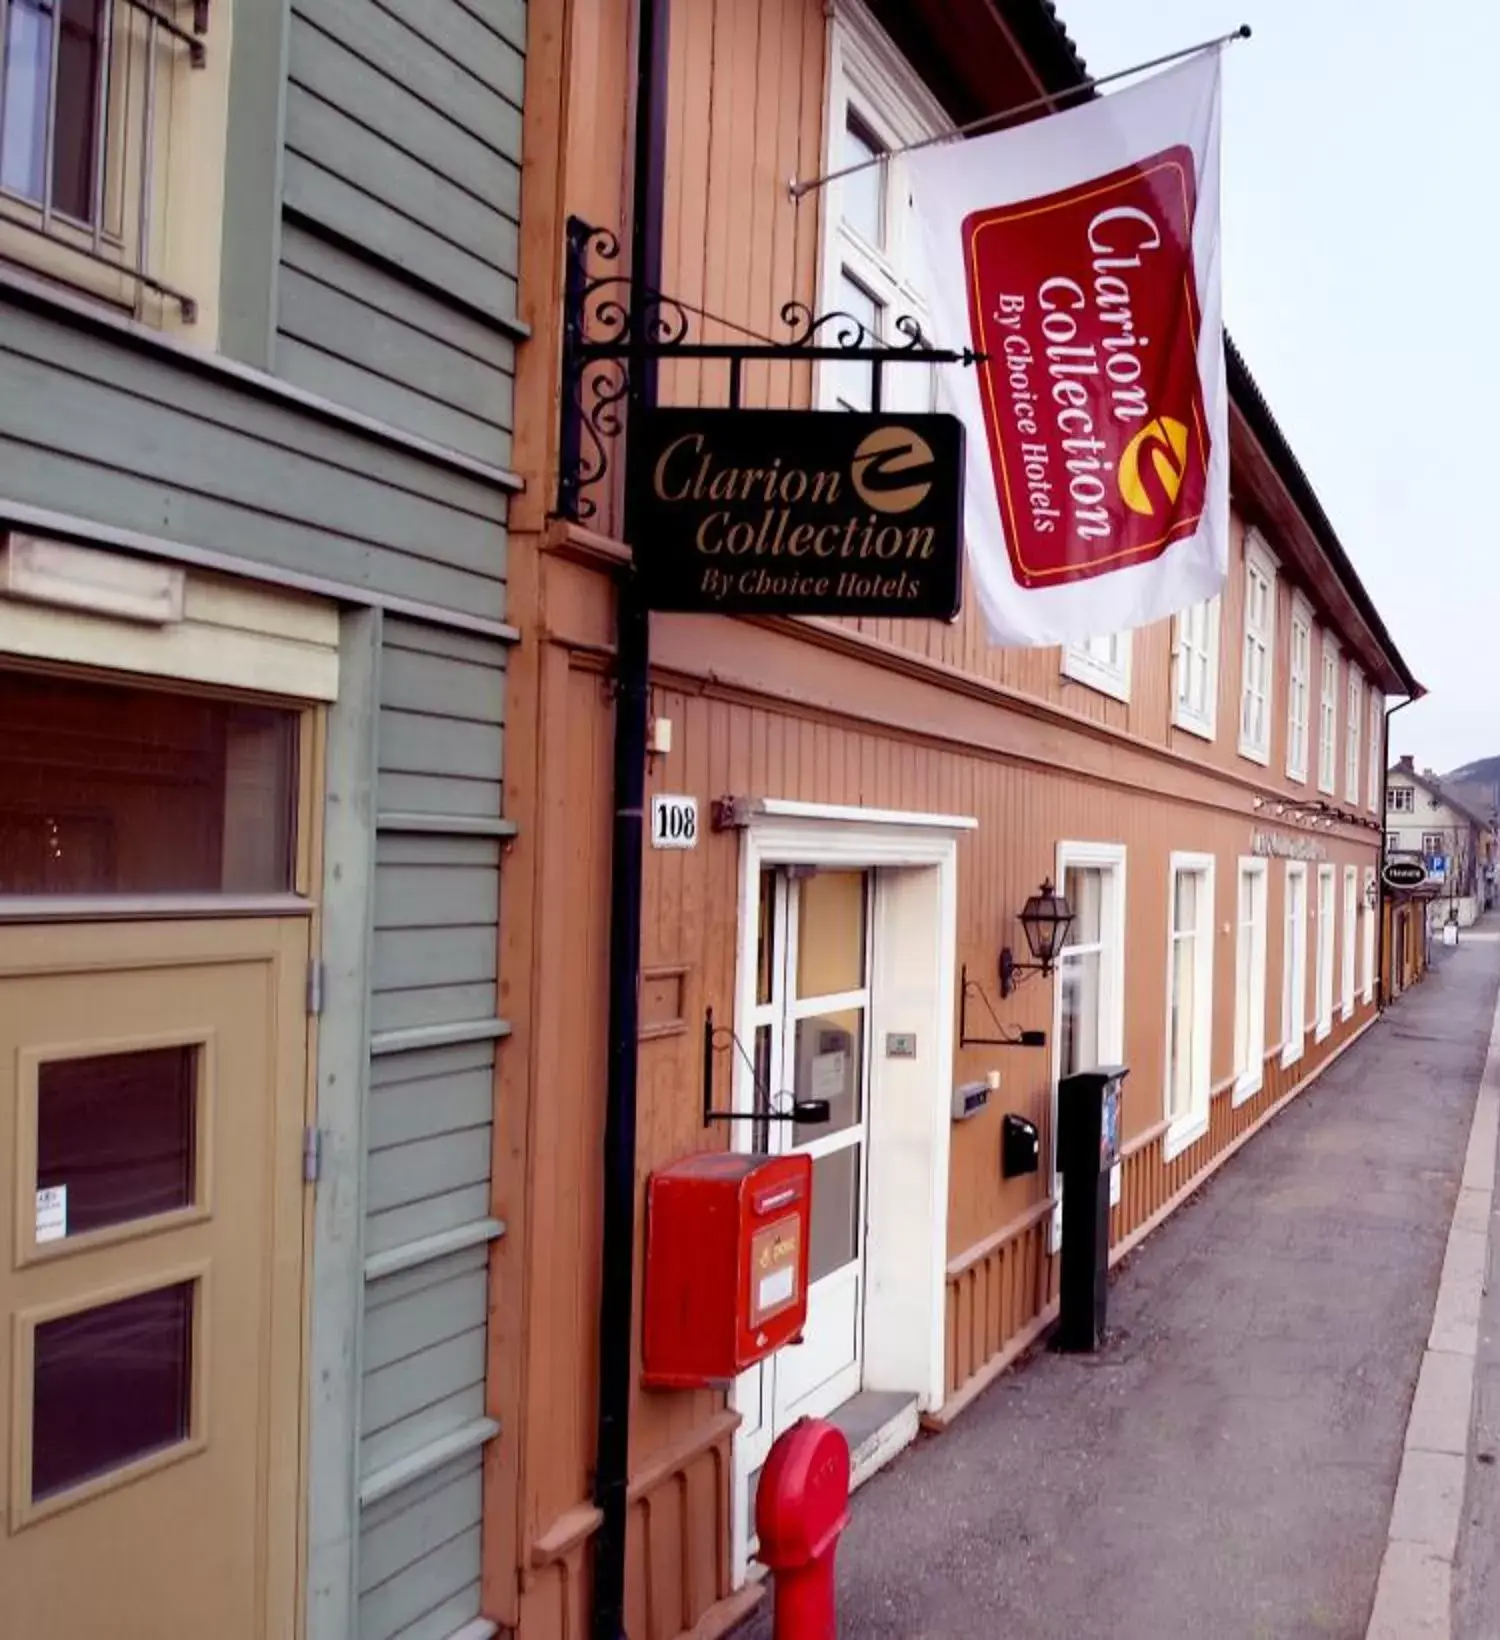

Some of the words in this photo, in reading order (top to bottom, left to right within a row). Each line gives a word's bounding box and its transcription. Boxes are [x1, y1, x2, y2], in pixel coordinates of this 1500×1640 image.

[993, 292, 1025, 330] By
[1087, 206, 1160, 423] Clarion
[1004, 335, 1039, 436] Choice
[1038, 276, 1112, 541] Collection
[654, 433, 842, 504] Clarion
[1021, 442, 1061, 534] Hotels
[695, 508, 935, 559] Collection
[700, 568, 734, 600] By
[739, 569, 829, 597] Choice
[836, 571, 920, 599] Hotels
[658, 804, 695, 839] 108
